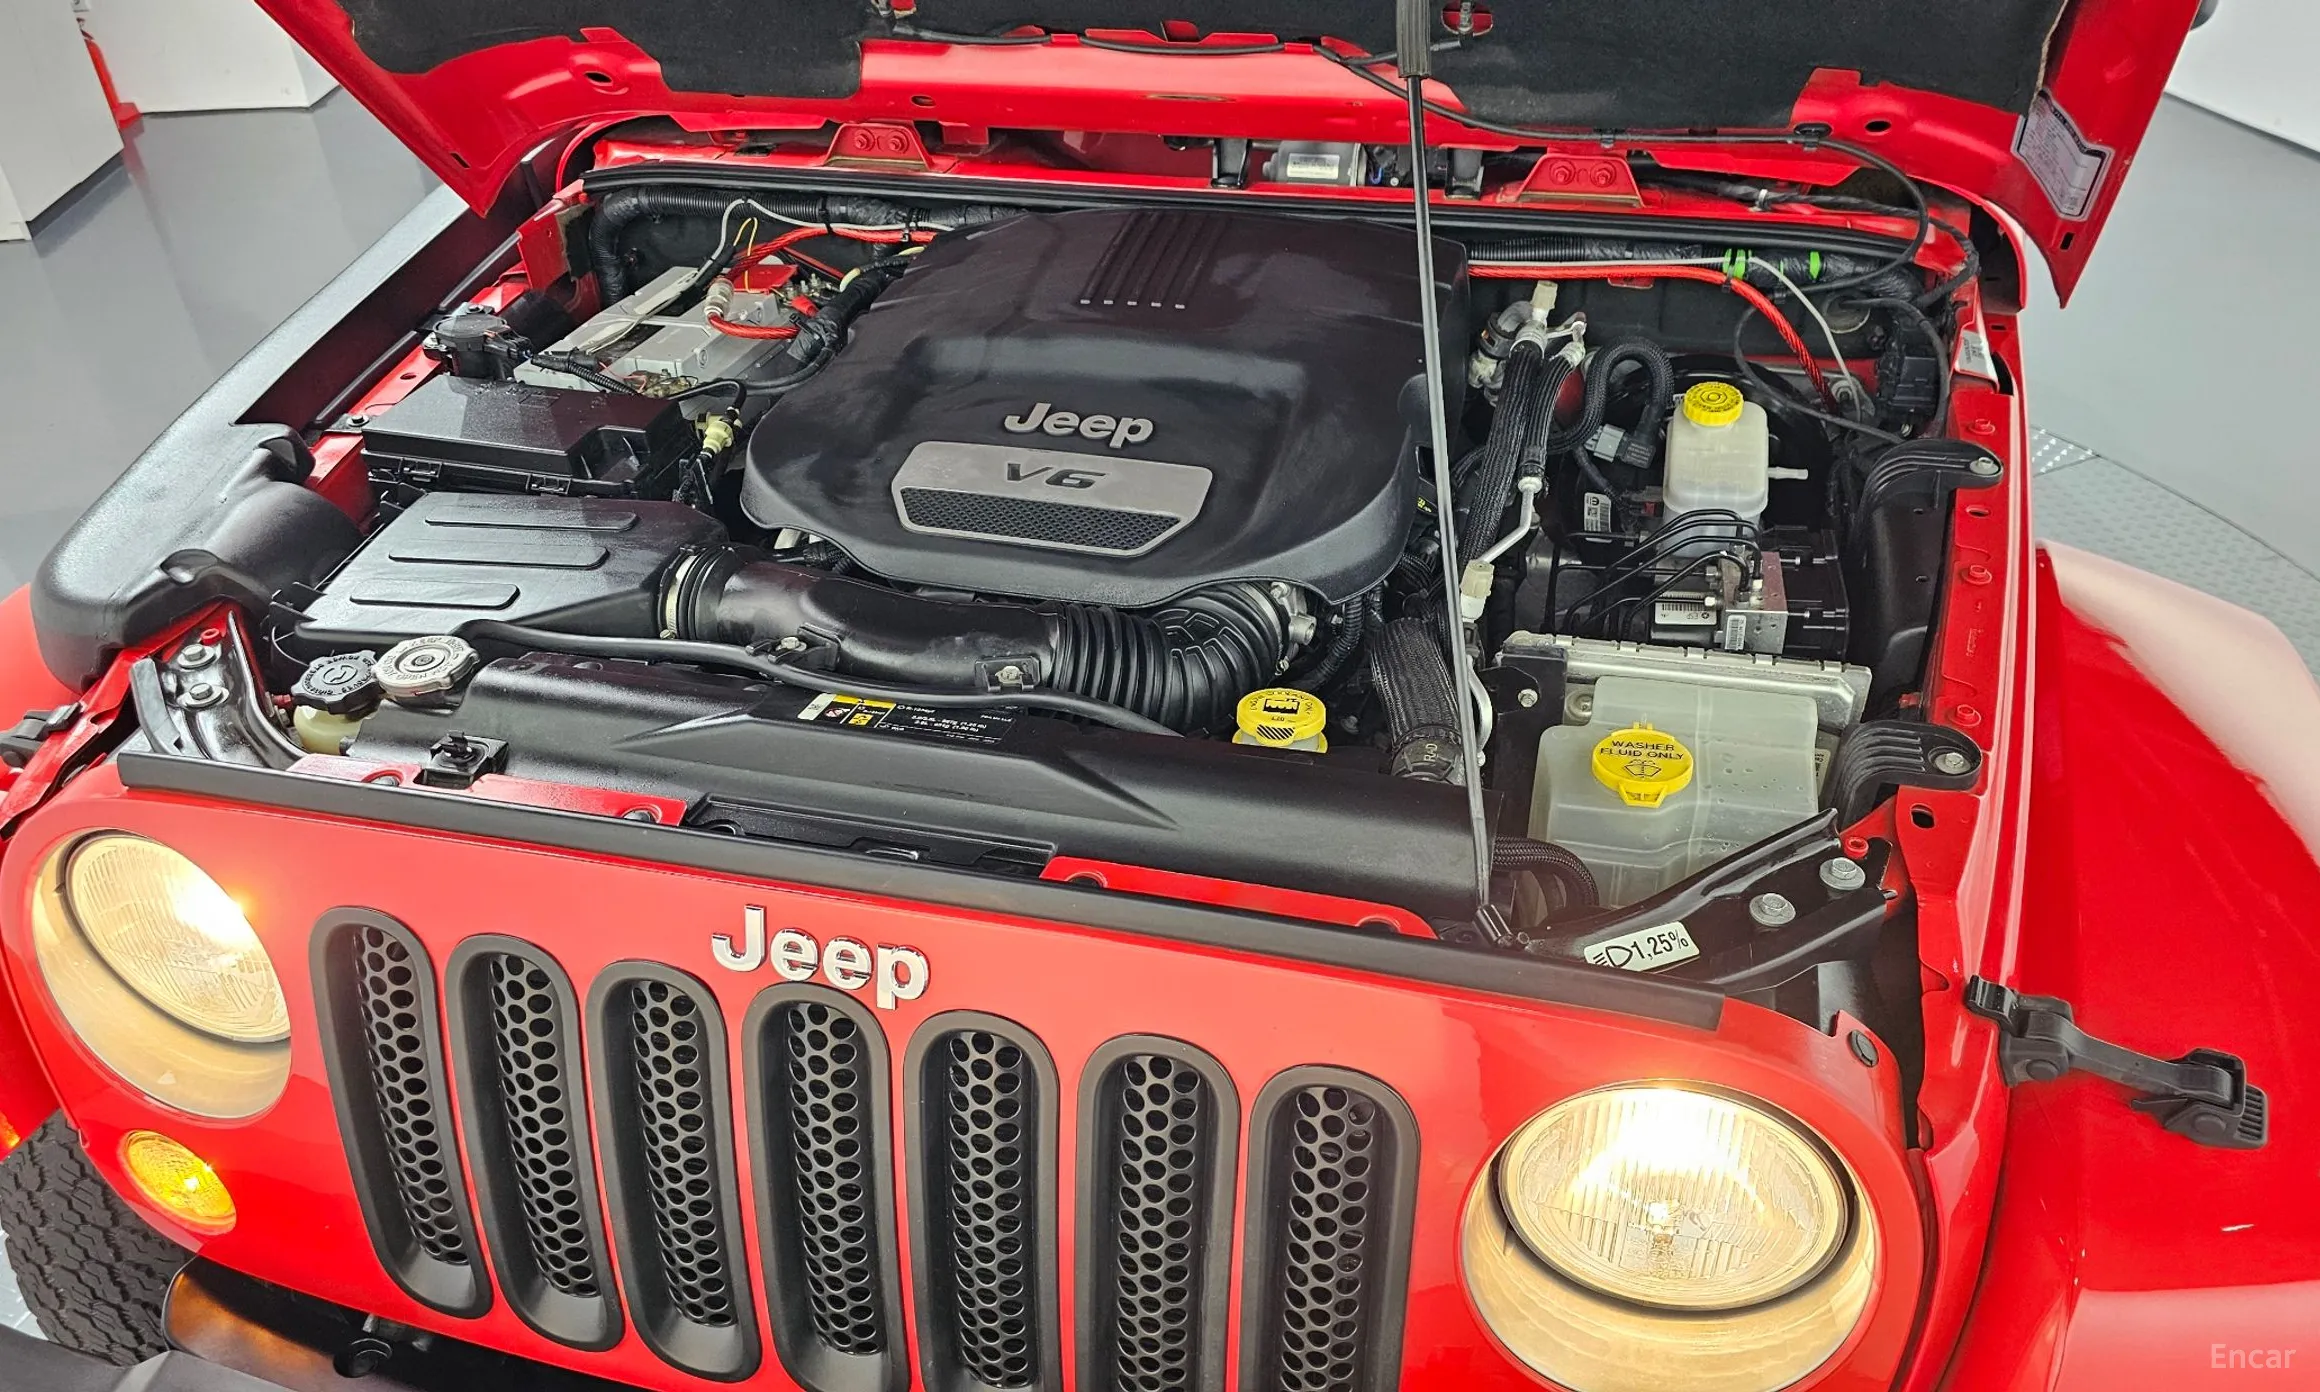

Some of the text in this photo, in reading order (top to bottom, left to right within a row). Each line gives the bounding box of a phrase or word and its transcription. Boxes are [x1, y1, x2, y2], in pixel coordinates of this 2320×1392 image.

[1003, 402, 1154, 449] Jeep
[1006, 462, 1107, 489] V6
[1423, 743, 1438, 762] RAD
[1600, 747, 1684, 760] FLUID ONLY
[1611, 740, 1675, 751] WASHER
[711, 903, 931, 1011] Jeep
[1631, 929, 1689, 960] 1,25%
